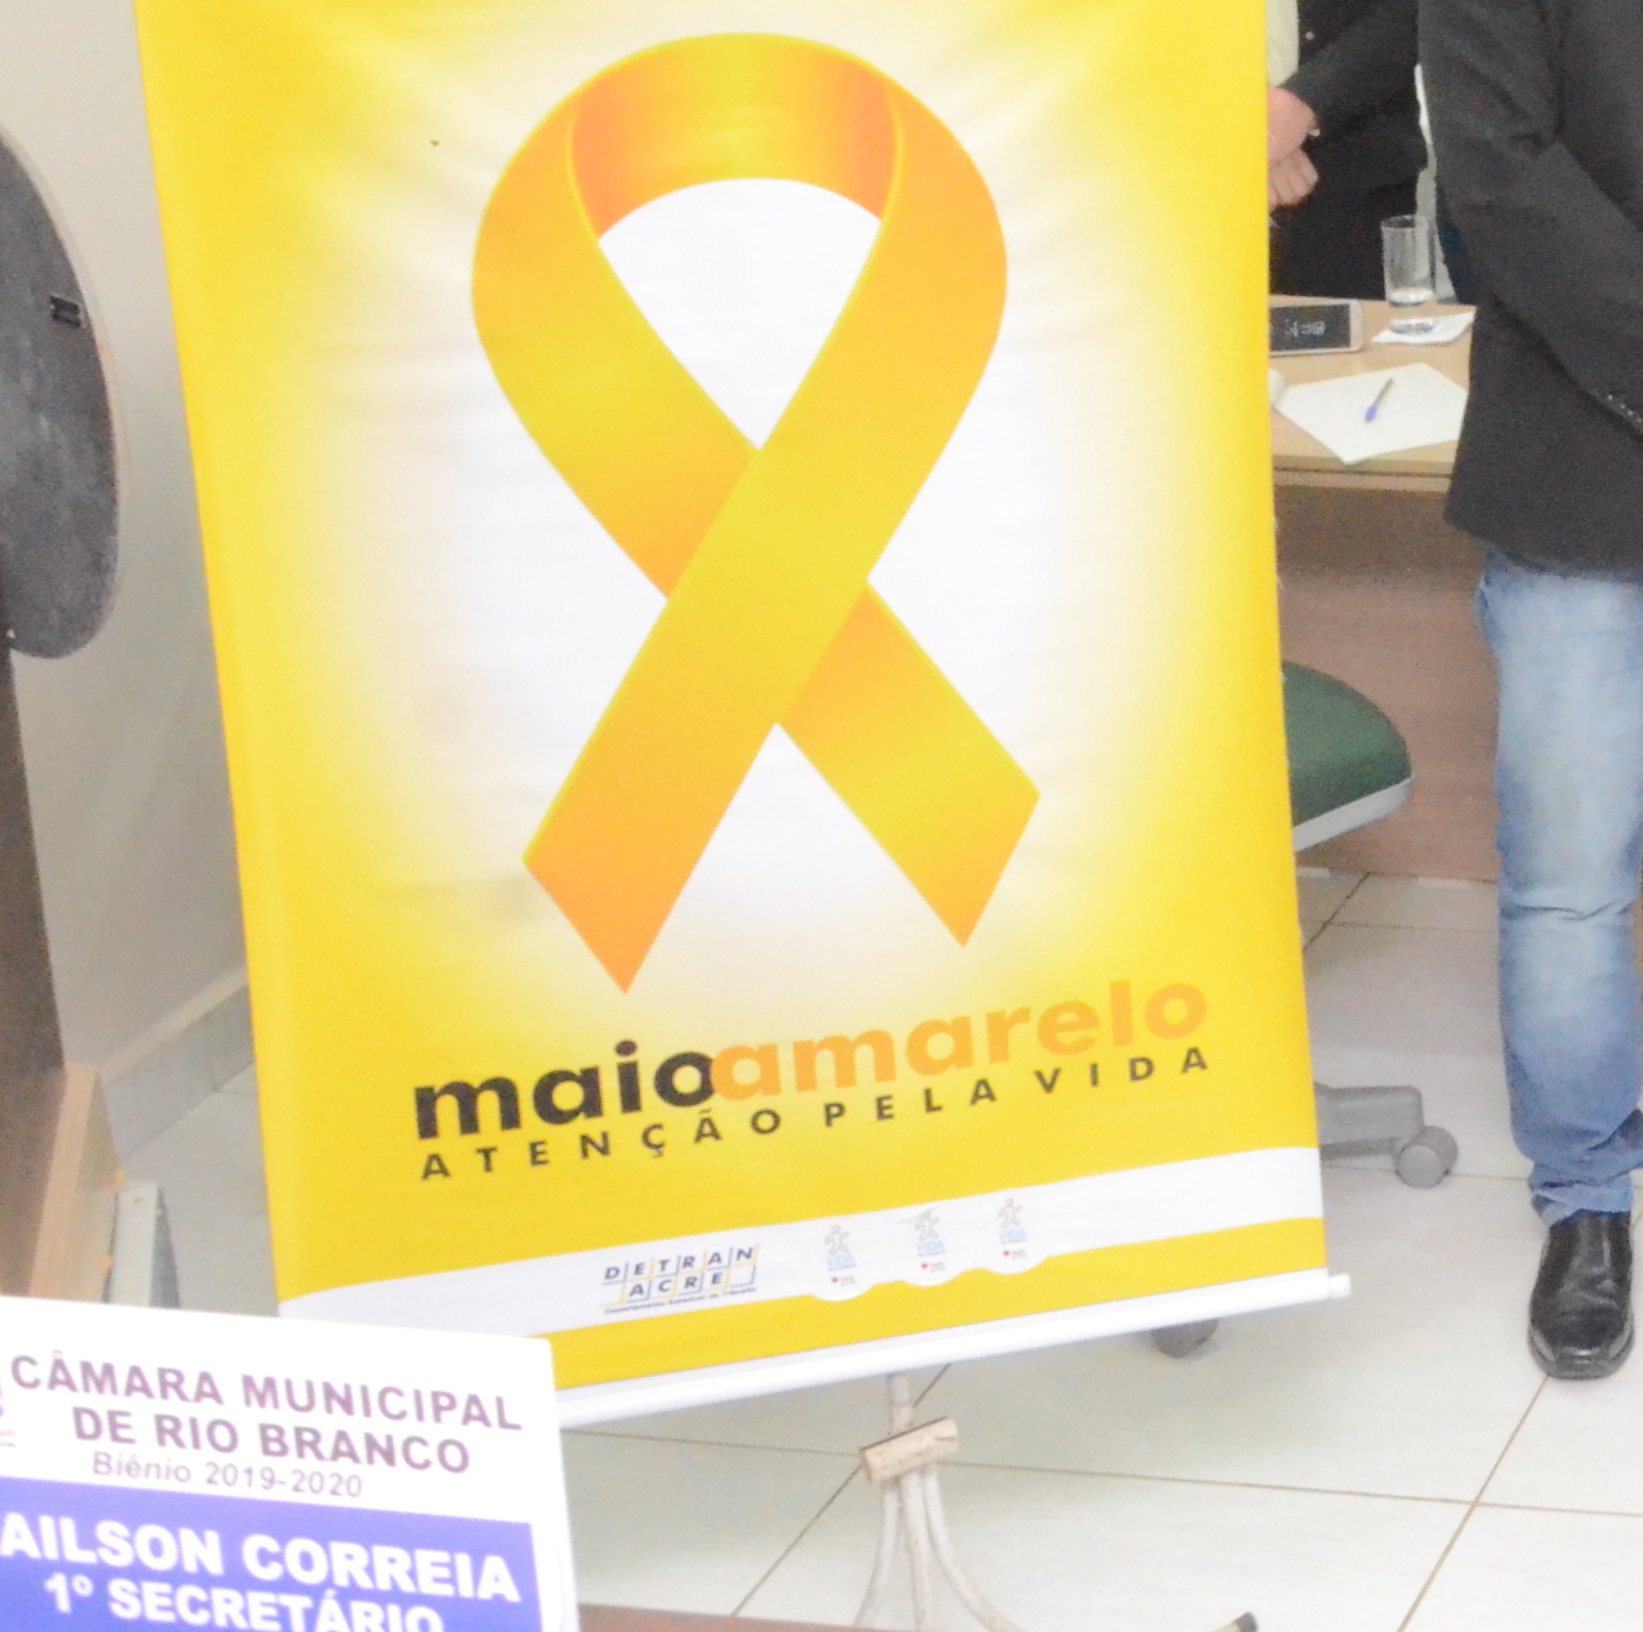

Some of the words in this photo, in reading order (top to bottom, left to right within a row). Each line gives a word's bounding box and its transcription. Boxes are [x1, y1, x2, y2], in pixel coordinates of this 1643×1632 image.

[421, 1108, 782, 1182] ATENÇÃO
[823, 1078, 997, 1129] PELA
[1034, 1045, 1209, 1094] VIDA
[604, 1247, 753, 1280] DETRAN
[628, 1272, 723, 1298] ACRE
[11, 1349, 225, 1406] CÂMARA
[241, 1374, 523, 1431] MUNICIPAL
[72, 1406, 137, 1445] DE
[153, 1412, 240, 1454] RIO
[258, 1421, 470, 1474] BRANCO
[92, 1451, 192, 1483] Biênio
[204, 1460, 363, 1499] 2019-2020
[0, 1511, 225, 1576] AILSON
[241, 1532, 523, 1603] CORREIA
[43, 1571, 95, 1615] 1º
[106, 1577, 445, 1632] SECRETÁRIO
